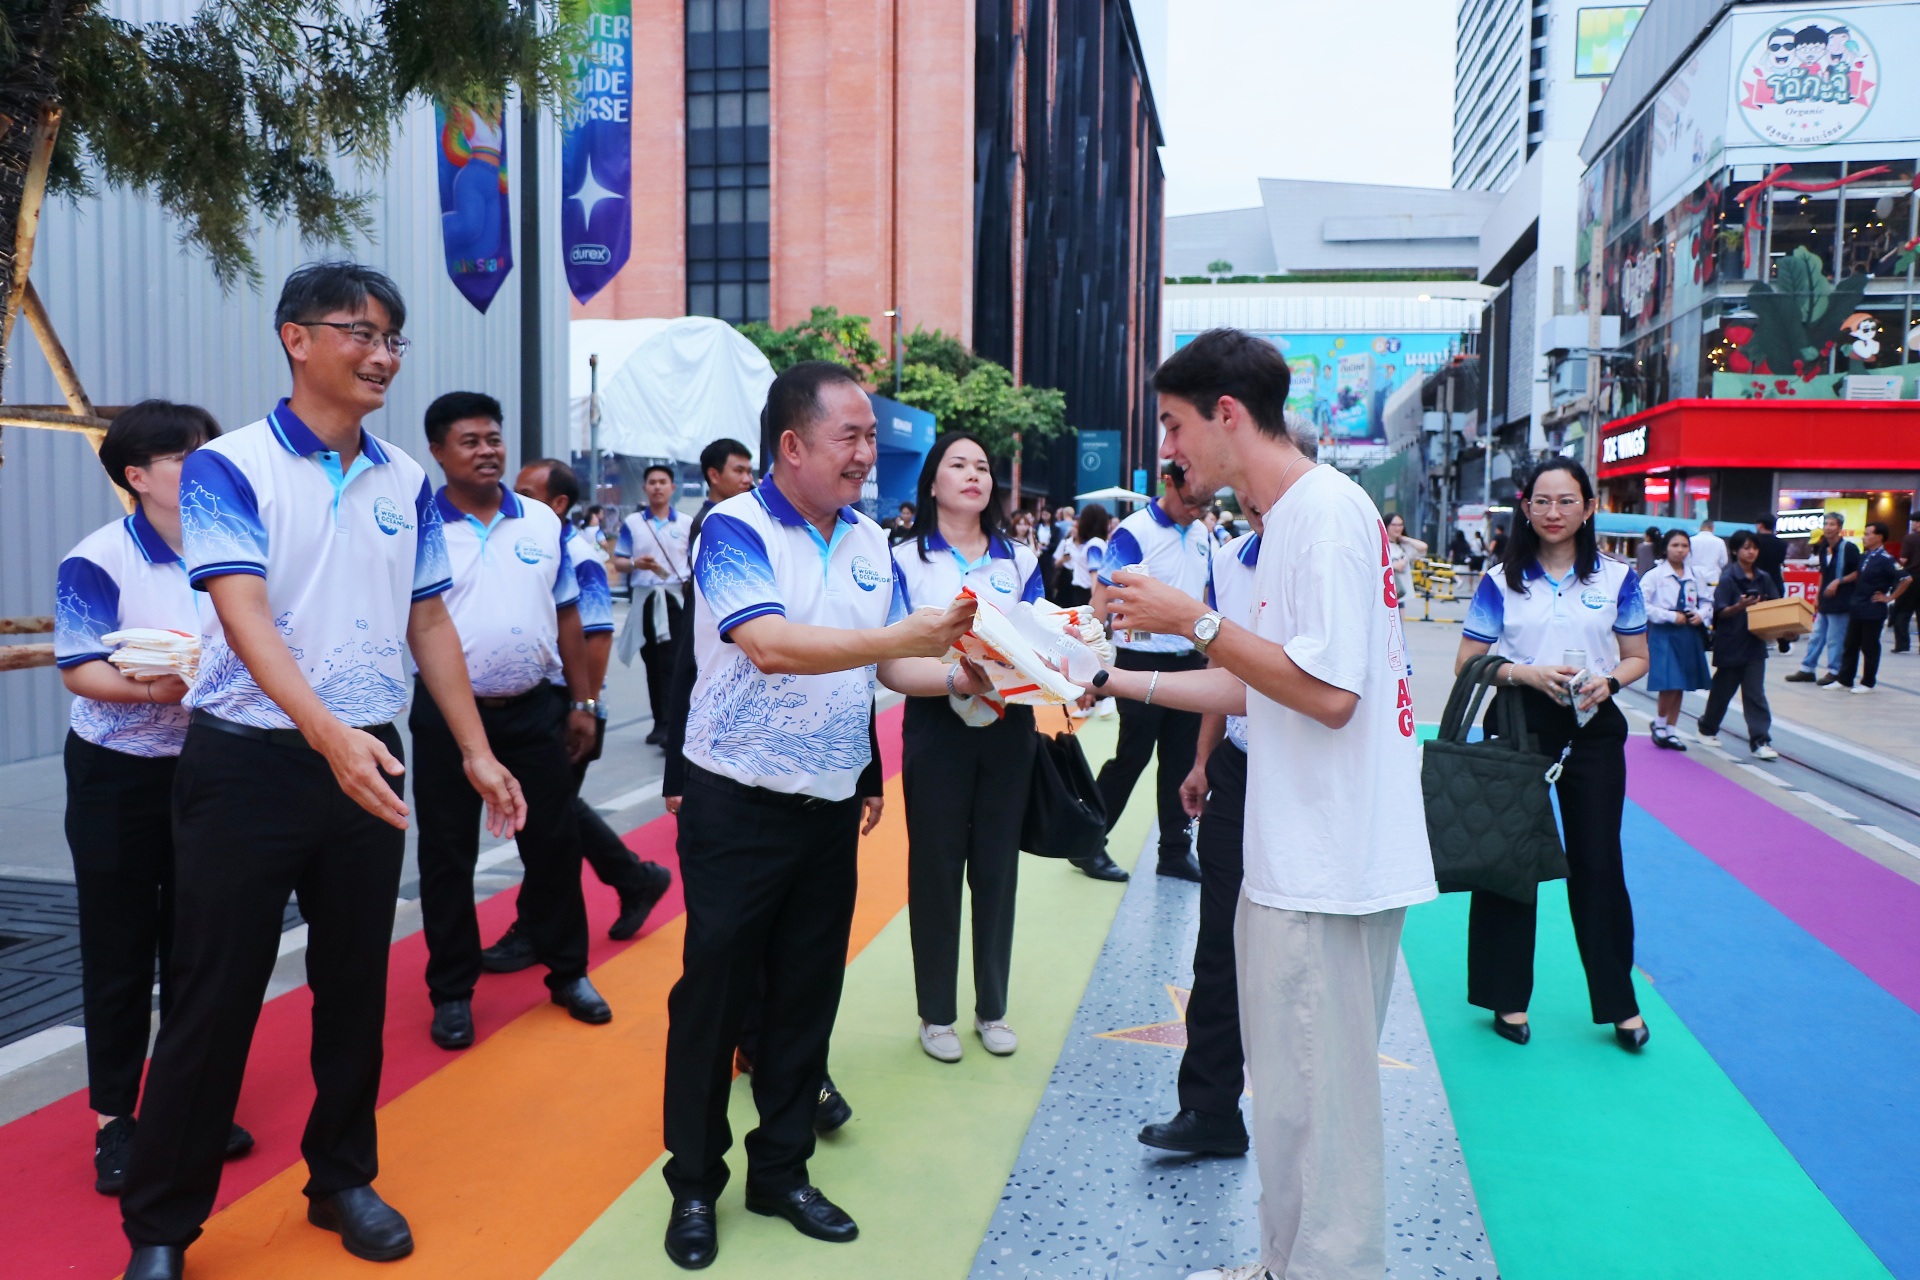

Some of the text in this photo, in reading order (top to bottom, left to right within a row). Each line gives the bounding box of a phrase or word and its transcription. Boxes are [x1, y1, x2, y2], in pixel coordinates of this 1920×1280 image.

[567, 40, 625, 75] YUR
[1785, 107, 1824, 117] Organic
[572, 247, 606, 261] durex
[381, 511, 403, 521] WORLD
[859, 569, 879, 577] WORLD
[859, 574, 891, 583] OCEANSDA
